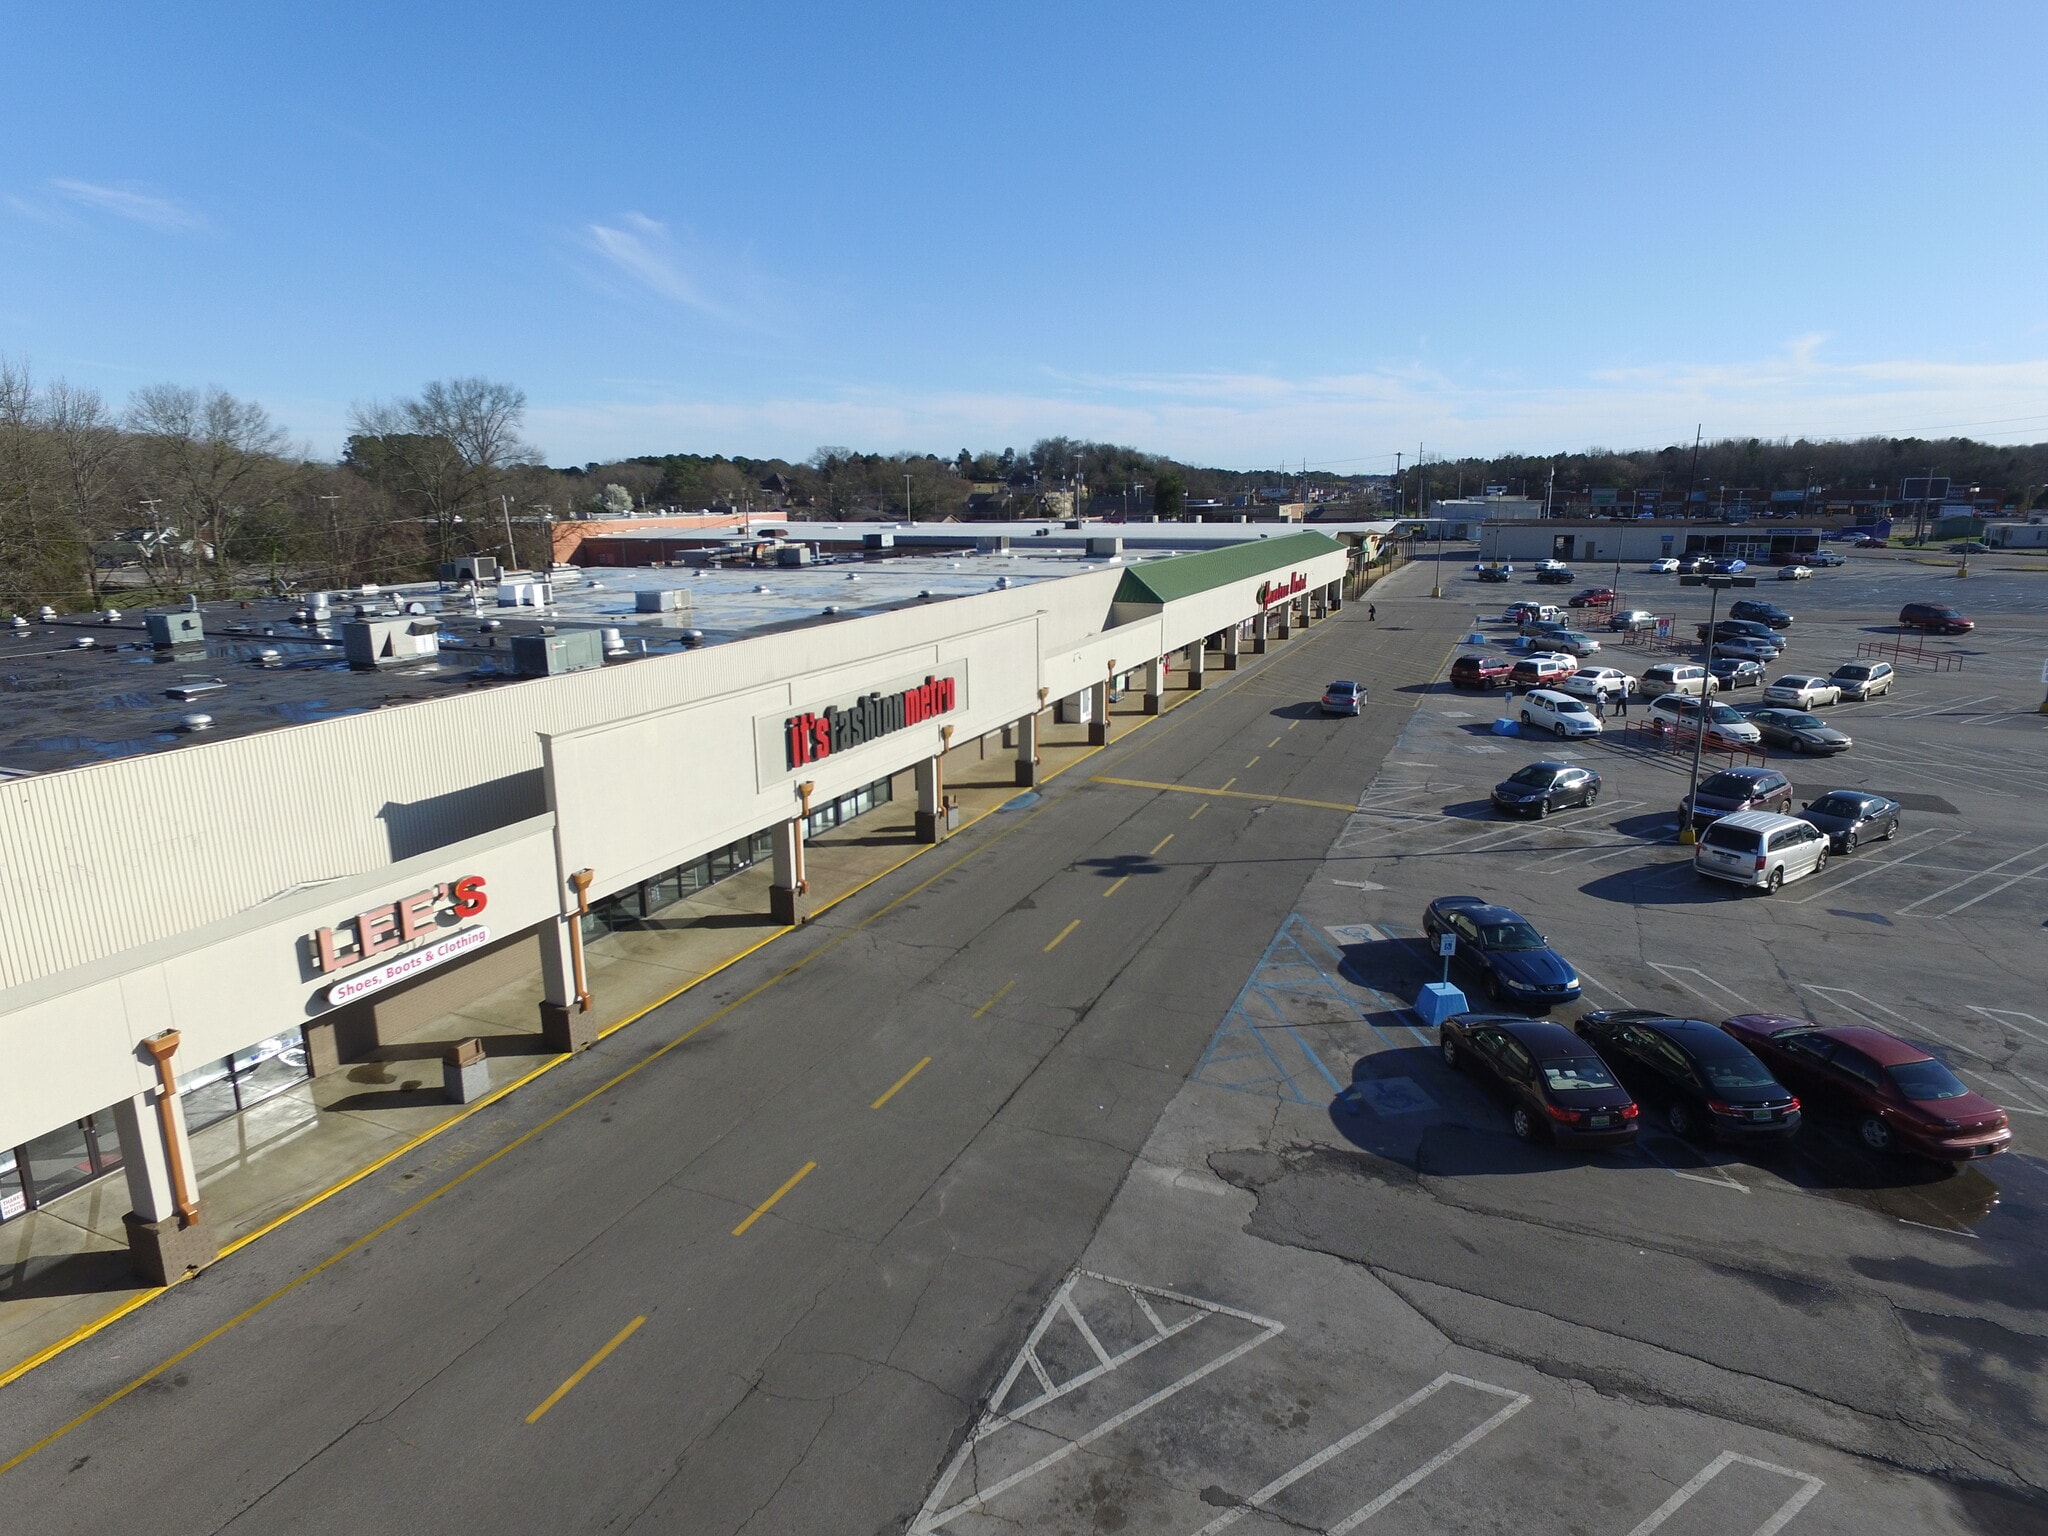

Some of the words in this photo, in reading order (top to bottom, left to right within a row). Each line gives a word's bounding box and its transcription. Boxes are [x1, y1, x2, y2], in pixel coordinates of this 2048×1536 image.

[315, 875, 488, 973] LEE'S
[337, 974, 382, 1000] Shoes,
[386, 956, 421, 979] Boots
[425, 951, 434, 962] &
[437, 929, 486, 957] Clothing
